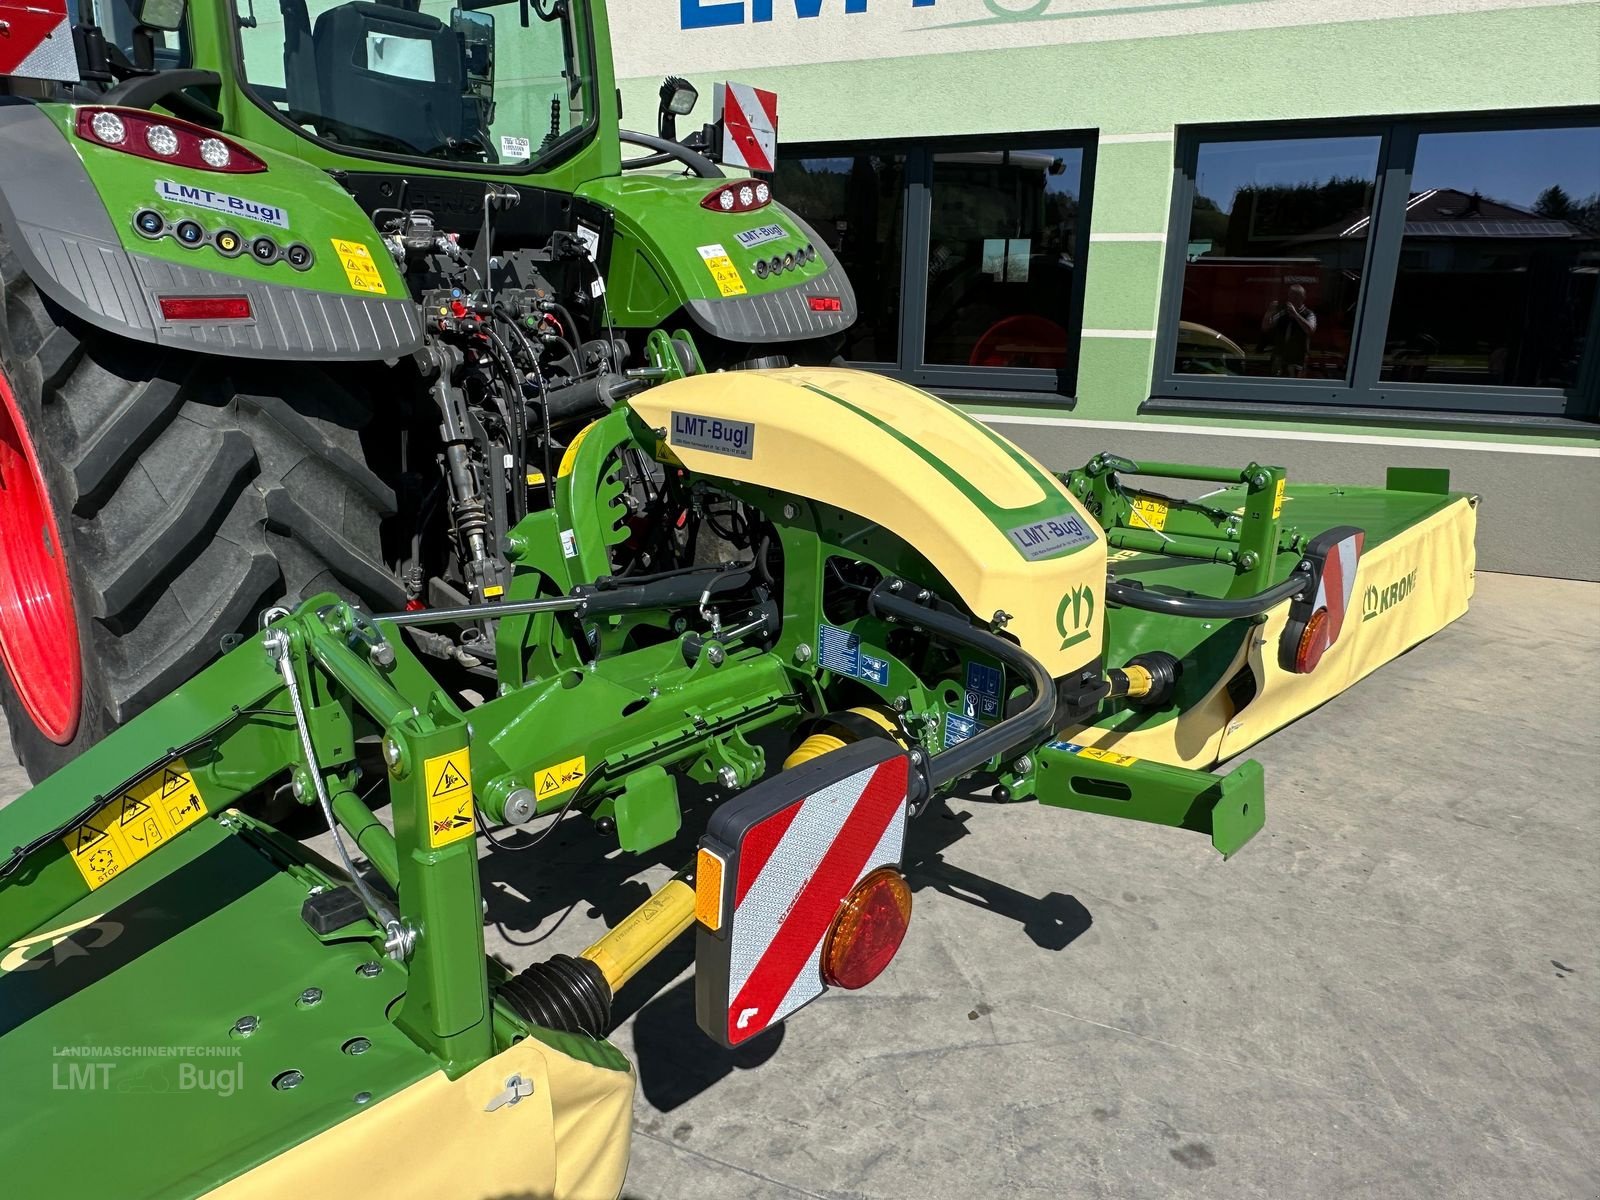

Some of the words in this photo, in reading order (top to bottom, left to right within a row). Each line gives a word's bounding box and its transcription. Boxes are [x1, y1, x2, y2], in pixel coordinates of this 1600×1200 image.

[163, 182, 281, 221] LMT-Bugl
[736, 224, 784, 243] LMT-Bugl
[675, 415, 749, 449] LMT-Bugl
[1013, 515, 1084, 548] LMT-Bugl
[97, 865, 119, 882] STOP
